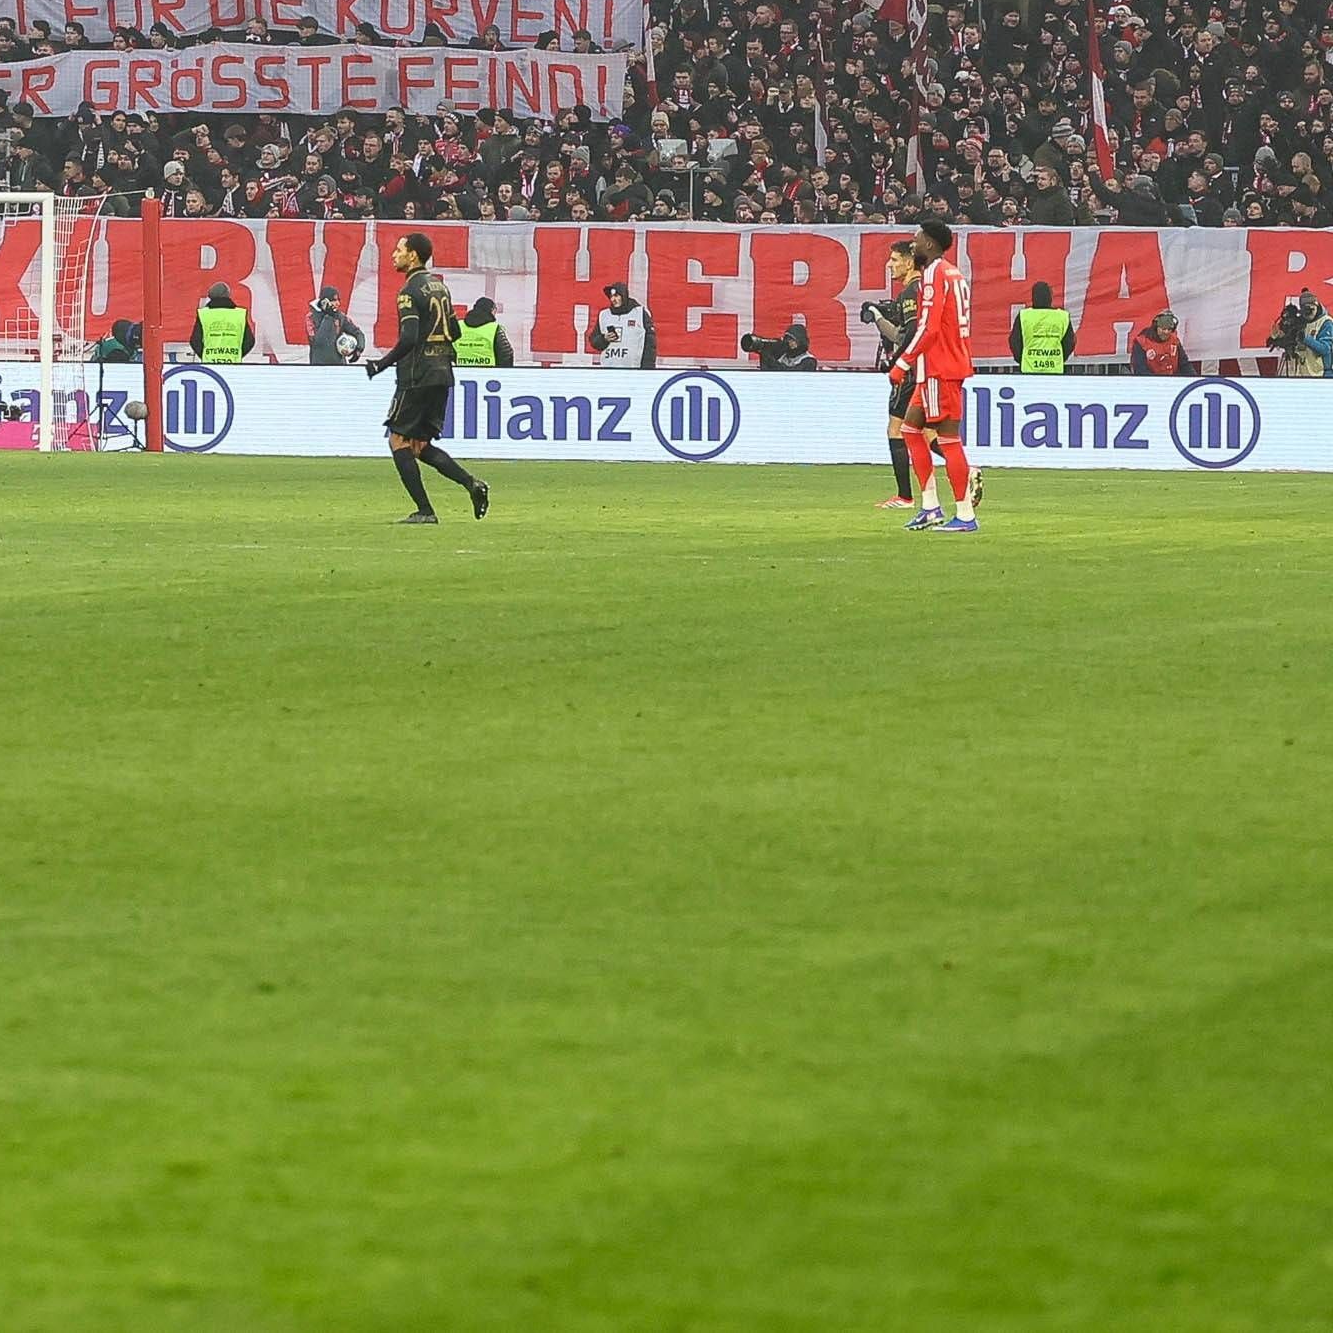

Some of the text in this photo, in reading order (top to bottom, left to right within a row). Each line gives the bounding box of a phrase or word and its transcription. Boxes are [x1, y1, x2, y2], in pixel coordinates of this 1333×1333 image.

[83, 54, 377, 112] GRÖSSTE
[399, 56, 608, 117] FEIND!
[605, 348, 629, 359] SMF
[393, 378, 632, 443] llianz
[961, 386, 1151, 450] llianz
